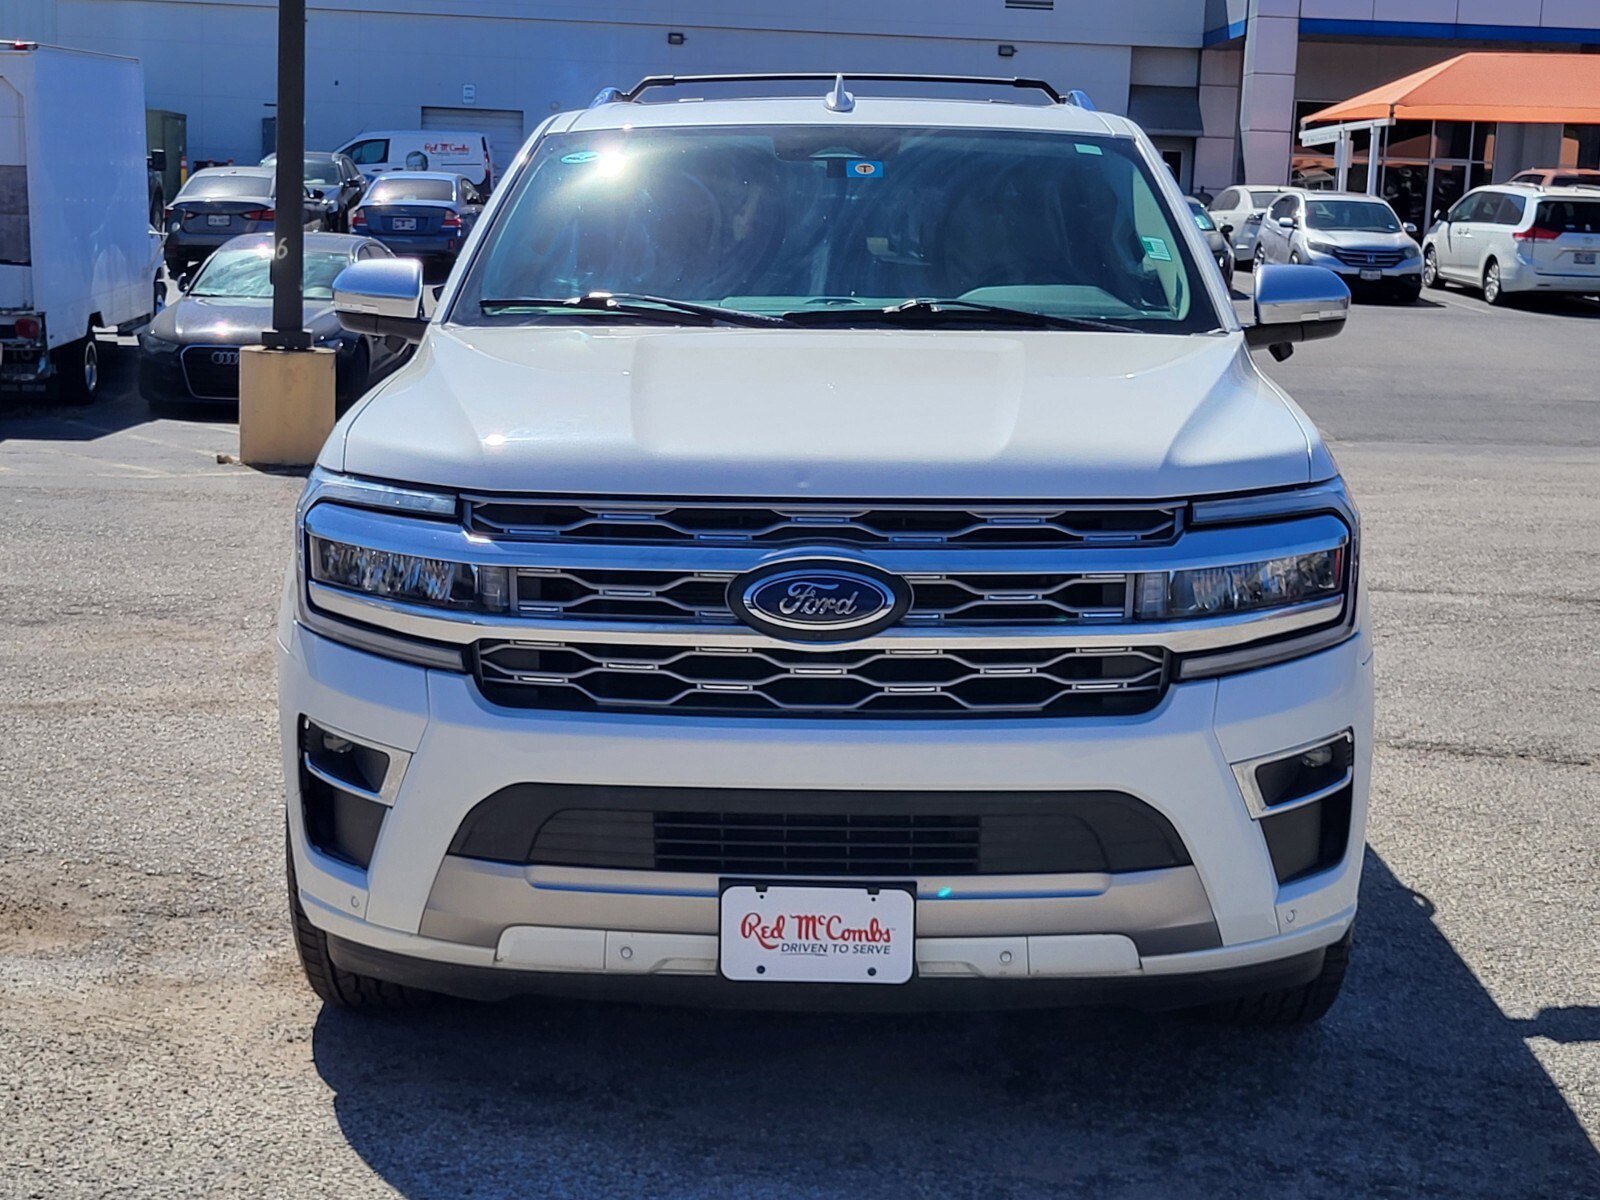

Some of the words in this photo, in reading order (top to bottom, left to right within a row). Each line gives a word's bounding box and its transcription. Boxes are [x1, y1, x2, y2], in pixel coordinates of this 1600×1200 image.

[277, 237, 288, 260] 6
[779, 582, 859, 614] Ford
[740, 912, 785, 949] Red
[790, 914, 891, 943] McCombs
[781, 942, 828, 954] DRIVEN
[832, 944, 849, 954] TO
[852, 944, 891, 955] SERVE
